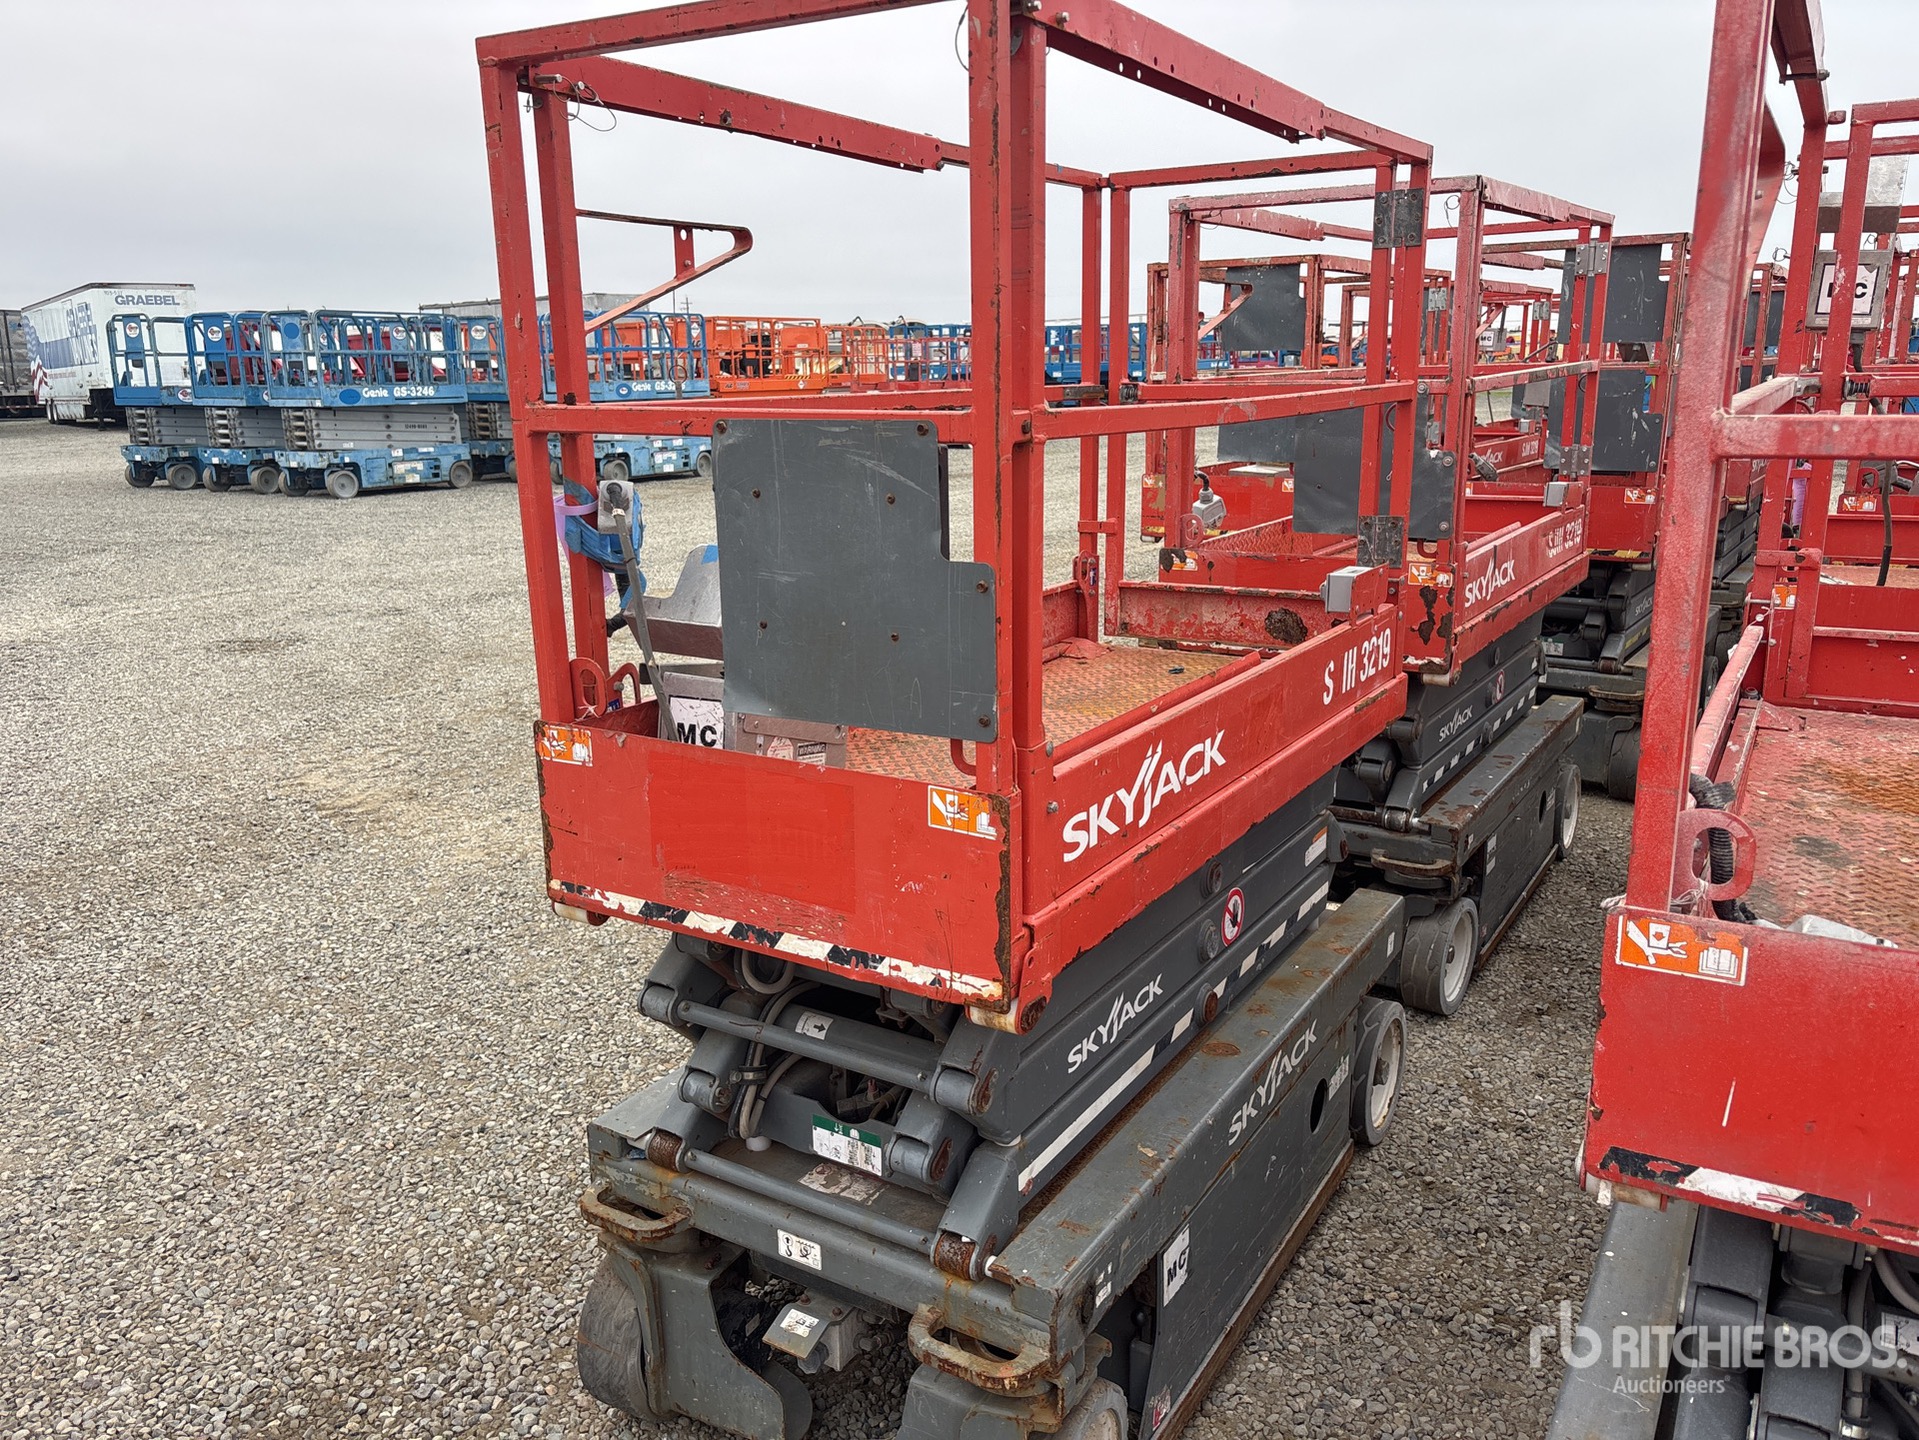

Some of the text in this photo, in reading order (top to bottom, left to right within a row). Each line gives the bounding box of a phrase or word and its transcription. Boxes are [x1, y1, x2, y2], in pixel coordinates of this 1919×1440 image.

[114, 294, 180, 306] GRAEBEL
[1827, 282, 1868, 299] C
[362, 385, 435, 398] Genie GS-3246
[655, 381, 686, 391] GS-326
[1464, 556, 1515, 608] SKYJACK
[1359, 627, 1391, 682] 3219
[676, 722, 718, 748] MC
[1438, 704, 1473, 743] SKYJACK
[797, 743, 827, 757] WARNING
[1062, 729, 1226, 863] SKYJACK
[1067, 973, 1164, 1074] SKYJACK
[1228, 1018, 1318, 1147] SKYJACK
[1166, 1247, 1188, 1288] MC
